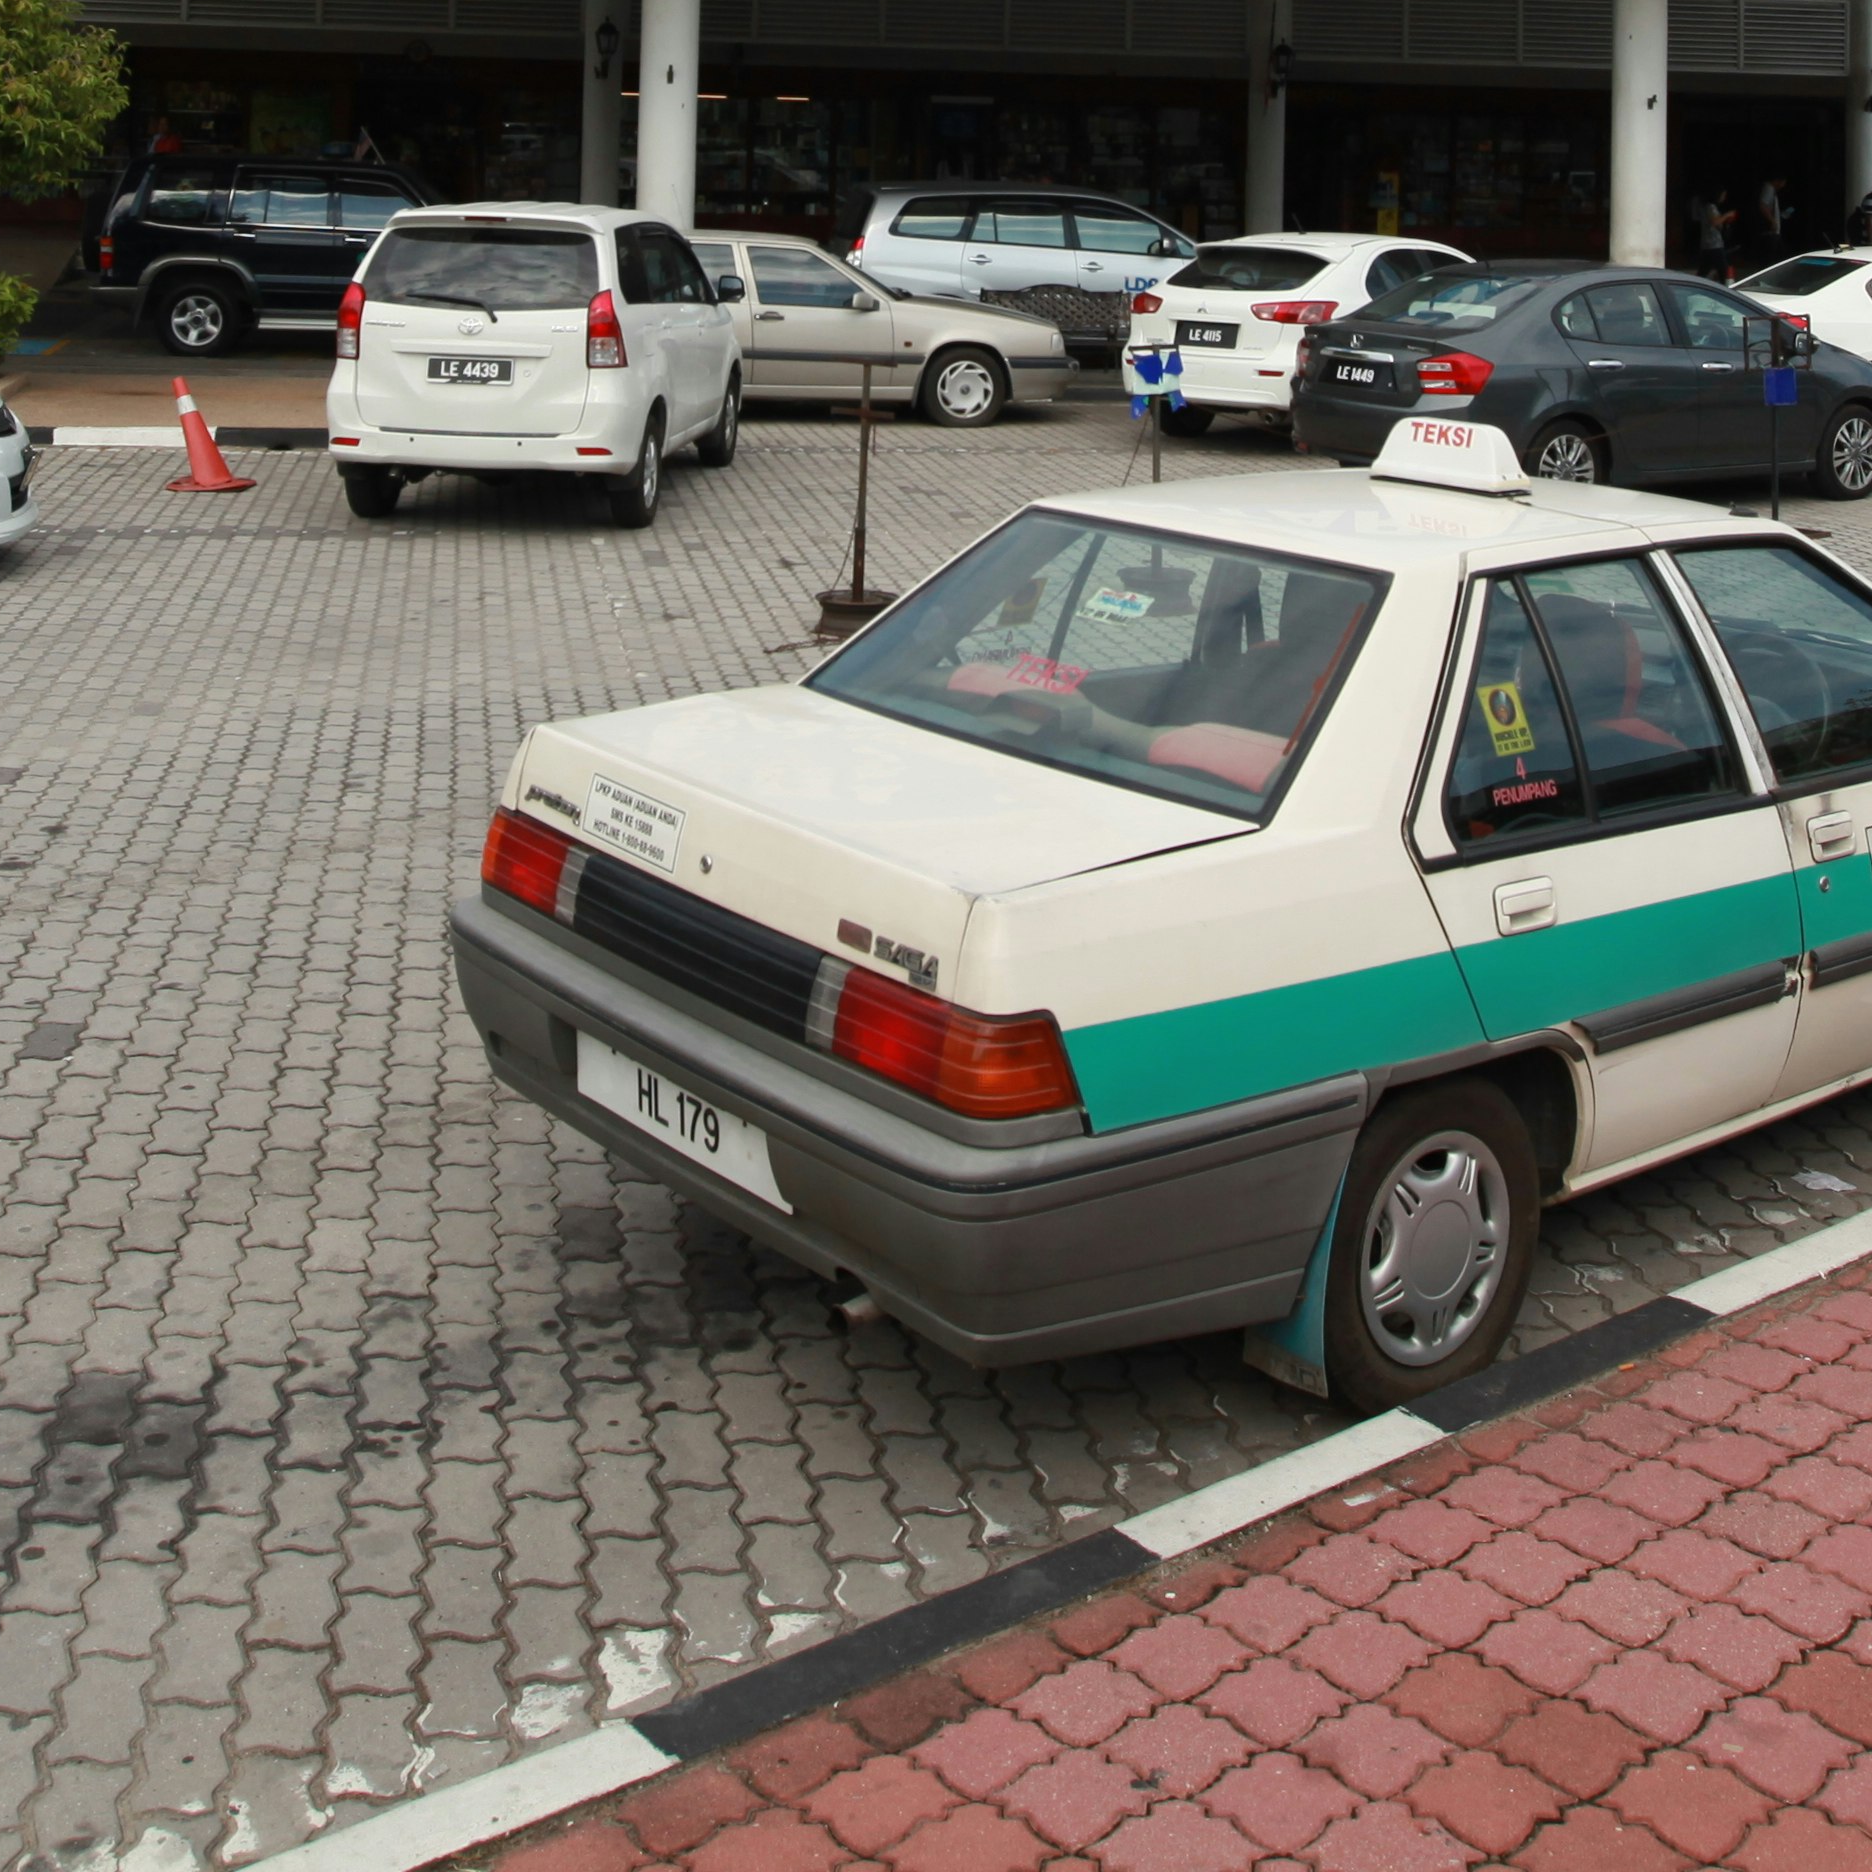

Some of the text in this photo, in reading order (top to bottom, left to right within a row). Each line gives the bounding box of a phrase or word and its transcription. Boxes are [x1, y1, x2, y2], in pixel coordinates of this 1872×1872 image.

[1188, 328, 1222, 342] LE 4115
[440, 361, 499, 378] LE 4439
[1336, 365, 1375, 383] LE 1449
[1411, 421, 1473, 449] TEKSI
[1005, 651, 1091, 695] TEKSI
[1516, 756, 1527, 780] 4
[594, 780, 612, 798] LPKP
[611, 788, 633, 808] ADUAN
[1492, 778, 1558, 807] PENUMPANG
[593, 818, 621, 842] HOTLINE
[610, 807, 625, 823] SMS
[625, 814, 634, 829] KE
[873, 935, 939, 978] SAGA
[637, 1067, 720, 1154] HL 179
